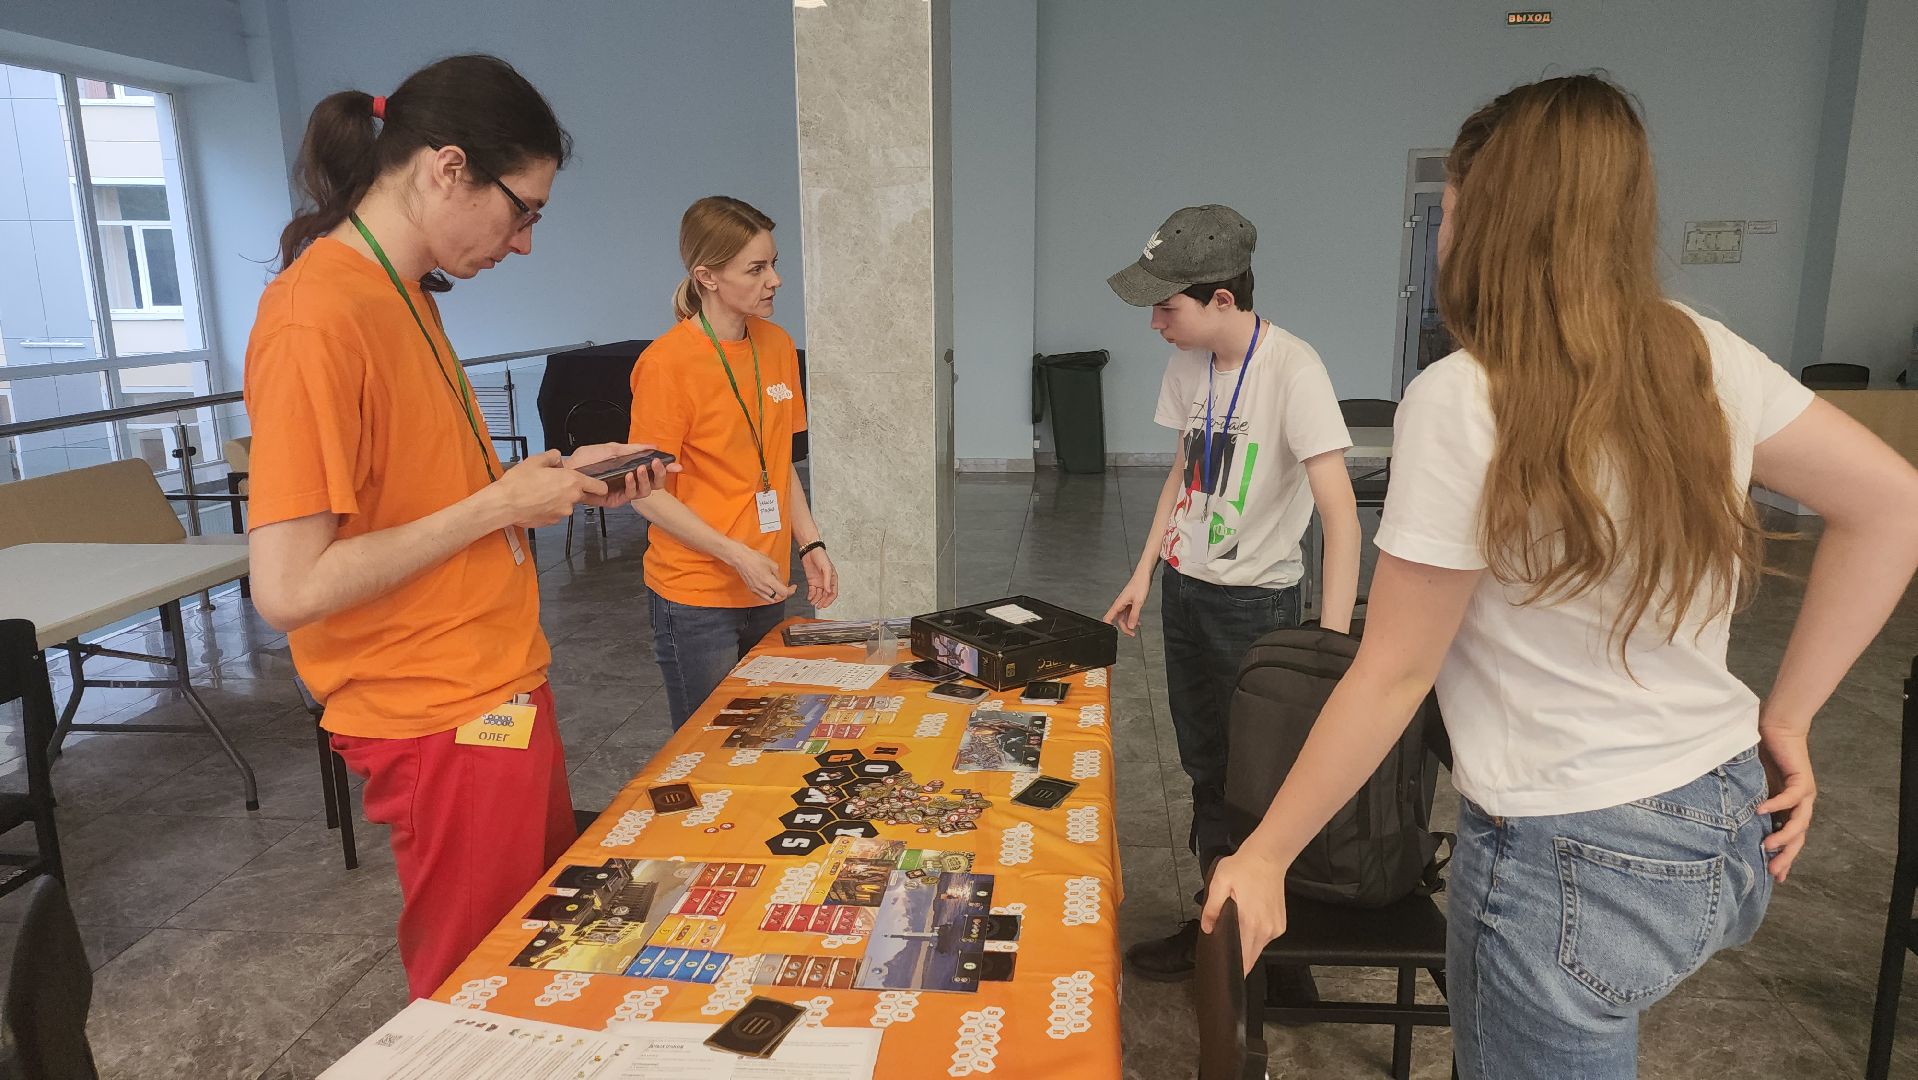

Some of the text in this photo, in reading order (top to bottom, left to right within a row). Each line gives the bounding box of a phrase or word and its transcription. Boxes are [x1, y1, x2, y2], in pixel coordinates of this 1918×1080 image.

[1508, 13, 1551, 23] ВЫХОД
[478, 731, 510, 742] ОЛЕГ
[1052, 979, 1070, 1036] HOBBY
[1073, 973, 1088, 1029] GAMES
[954, 1014, 979, 1073] HOBBY
[976, 1009, 999, 1068] GAMES
